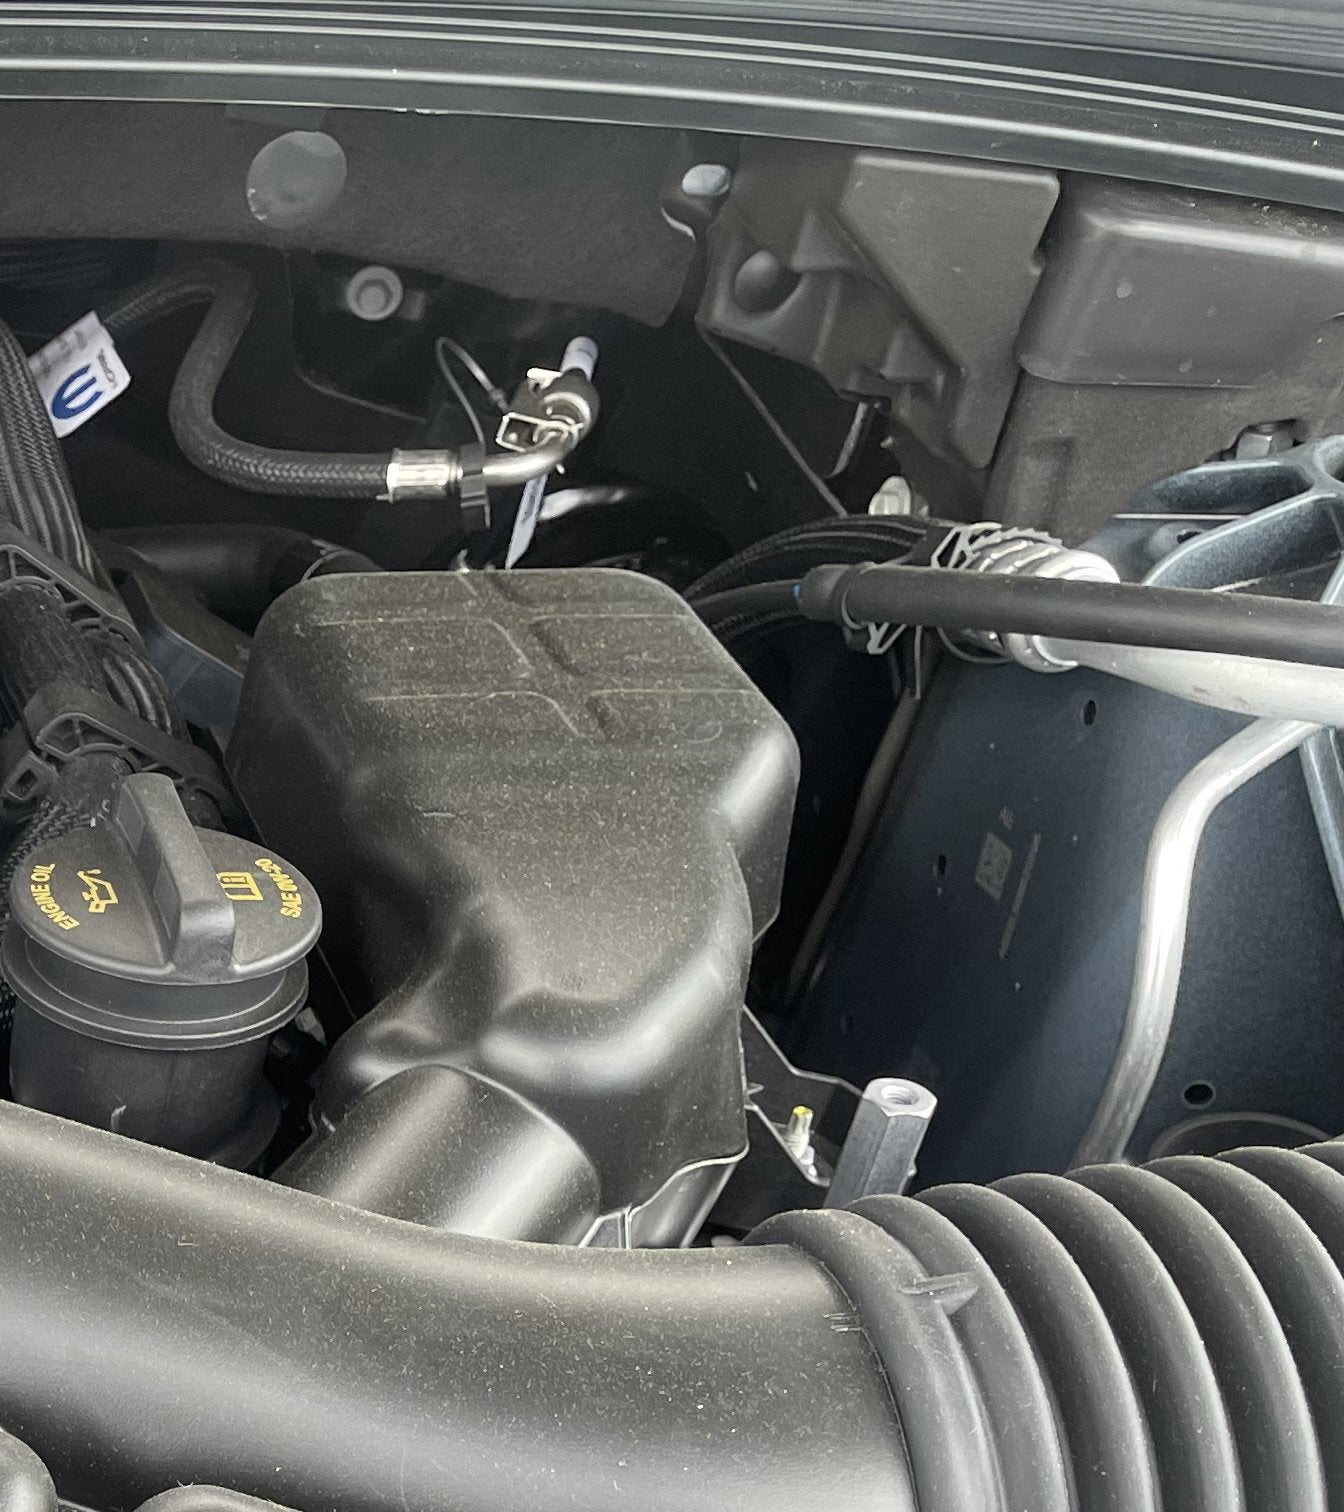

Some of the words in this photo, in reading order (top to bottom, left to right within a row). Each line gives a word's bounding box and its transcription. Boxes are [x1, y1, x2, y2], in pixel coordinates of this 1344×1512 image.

[30, 862, 57, 884] OIL
[30, 886, 81, 931] ENGINE
[279, 891, 303, 919] SAE
